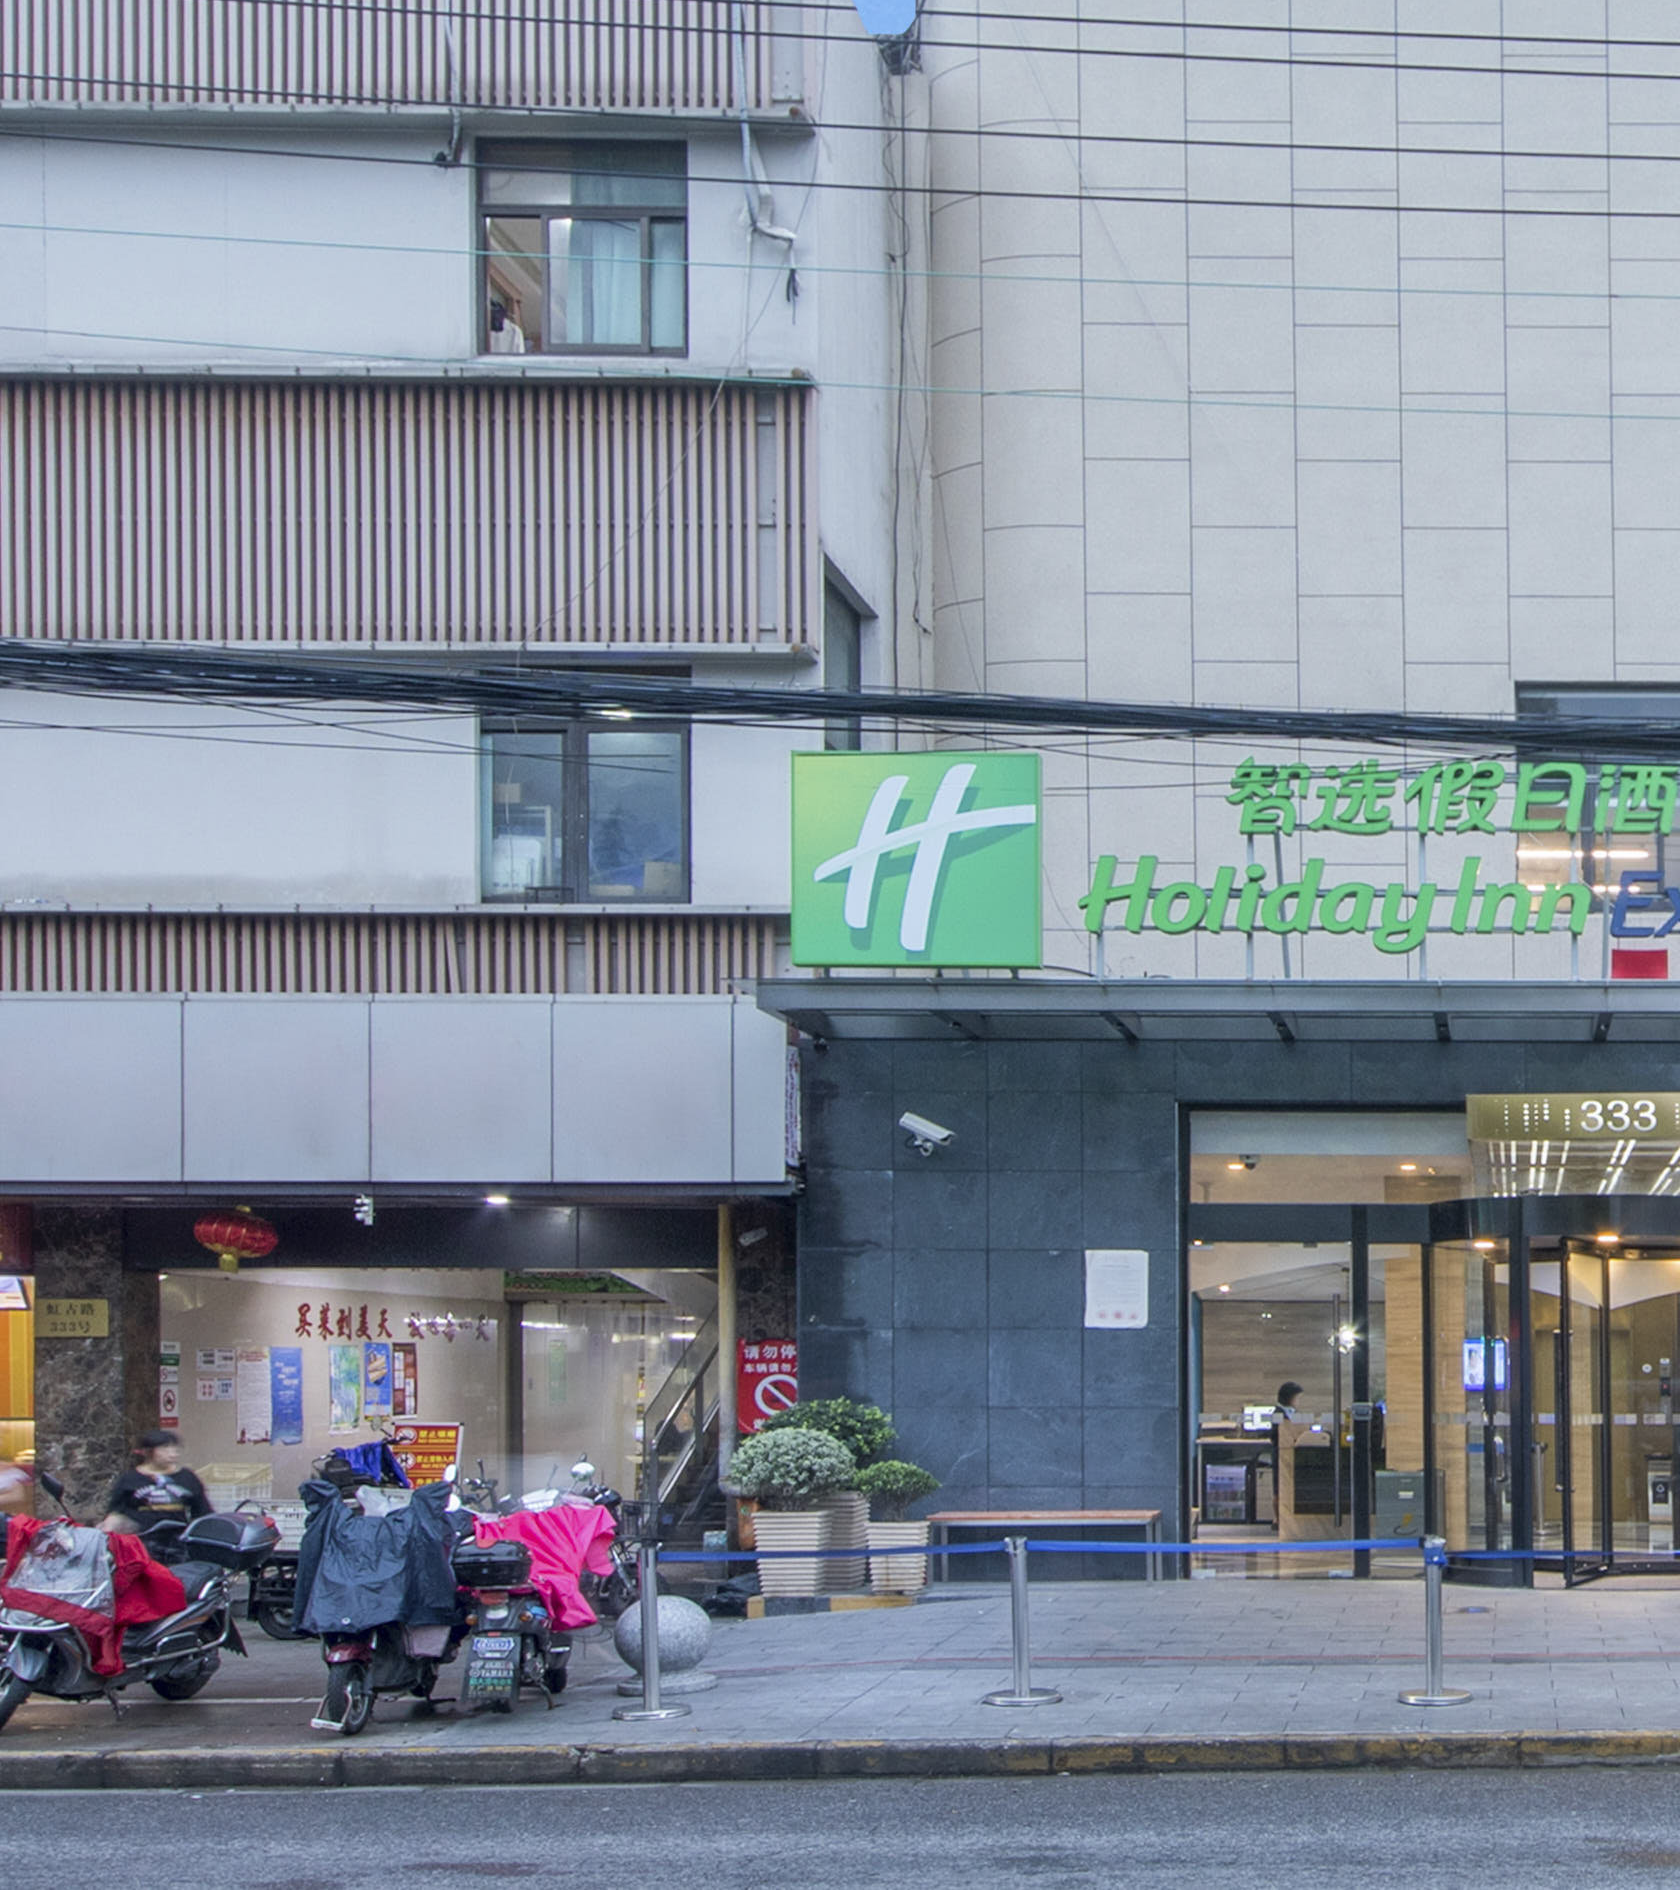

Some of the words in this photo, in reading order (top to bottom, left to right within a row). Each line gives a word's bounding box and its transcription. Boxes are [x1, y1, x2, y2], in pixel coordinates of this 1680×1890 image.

[1077, 855, 1436, 954] Holiday
[1454, 856, 1593, 937] Inn
[1580, 1100, 1658, 1133] 333
